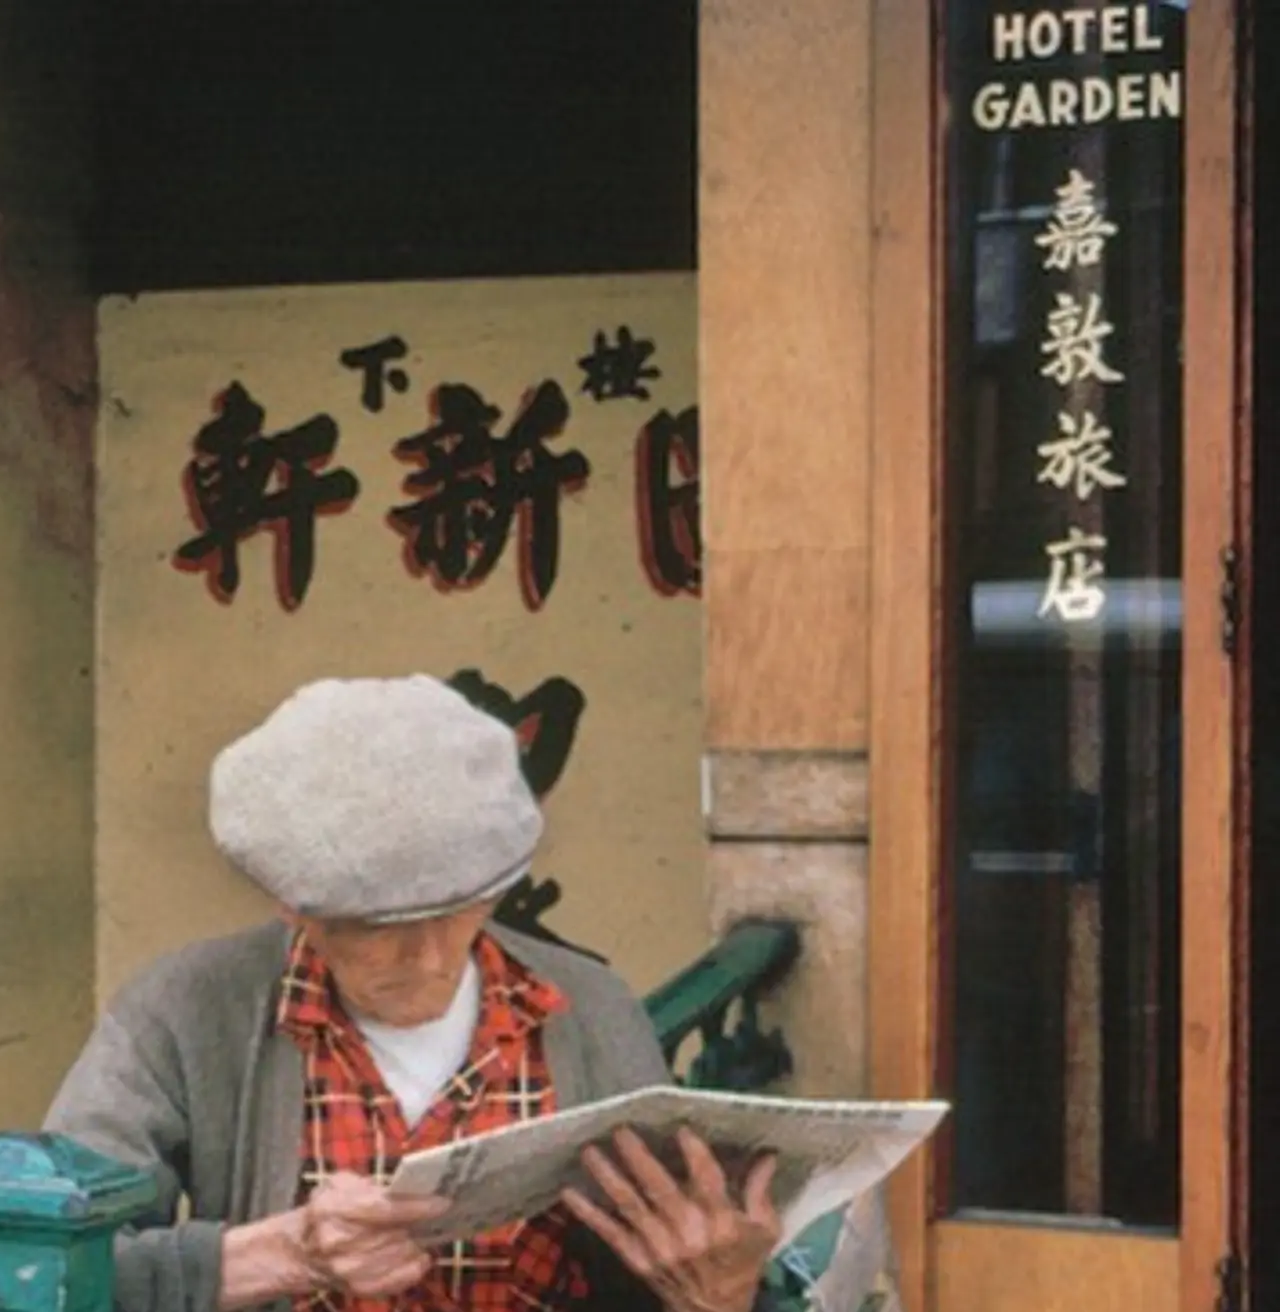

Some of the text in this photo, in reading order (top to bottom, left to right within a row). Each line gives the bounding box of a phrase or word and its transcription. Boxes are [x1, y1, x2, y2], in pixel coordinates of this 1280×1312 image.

[993, 4, 1164, 61] HOTEL
[973, 72, 1182, 131] GARDEN
[1036, 168, 1127, 624] 嘉敦旅店
